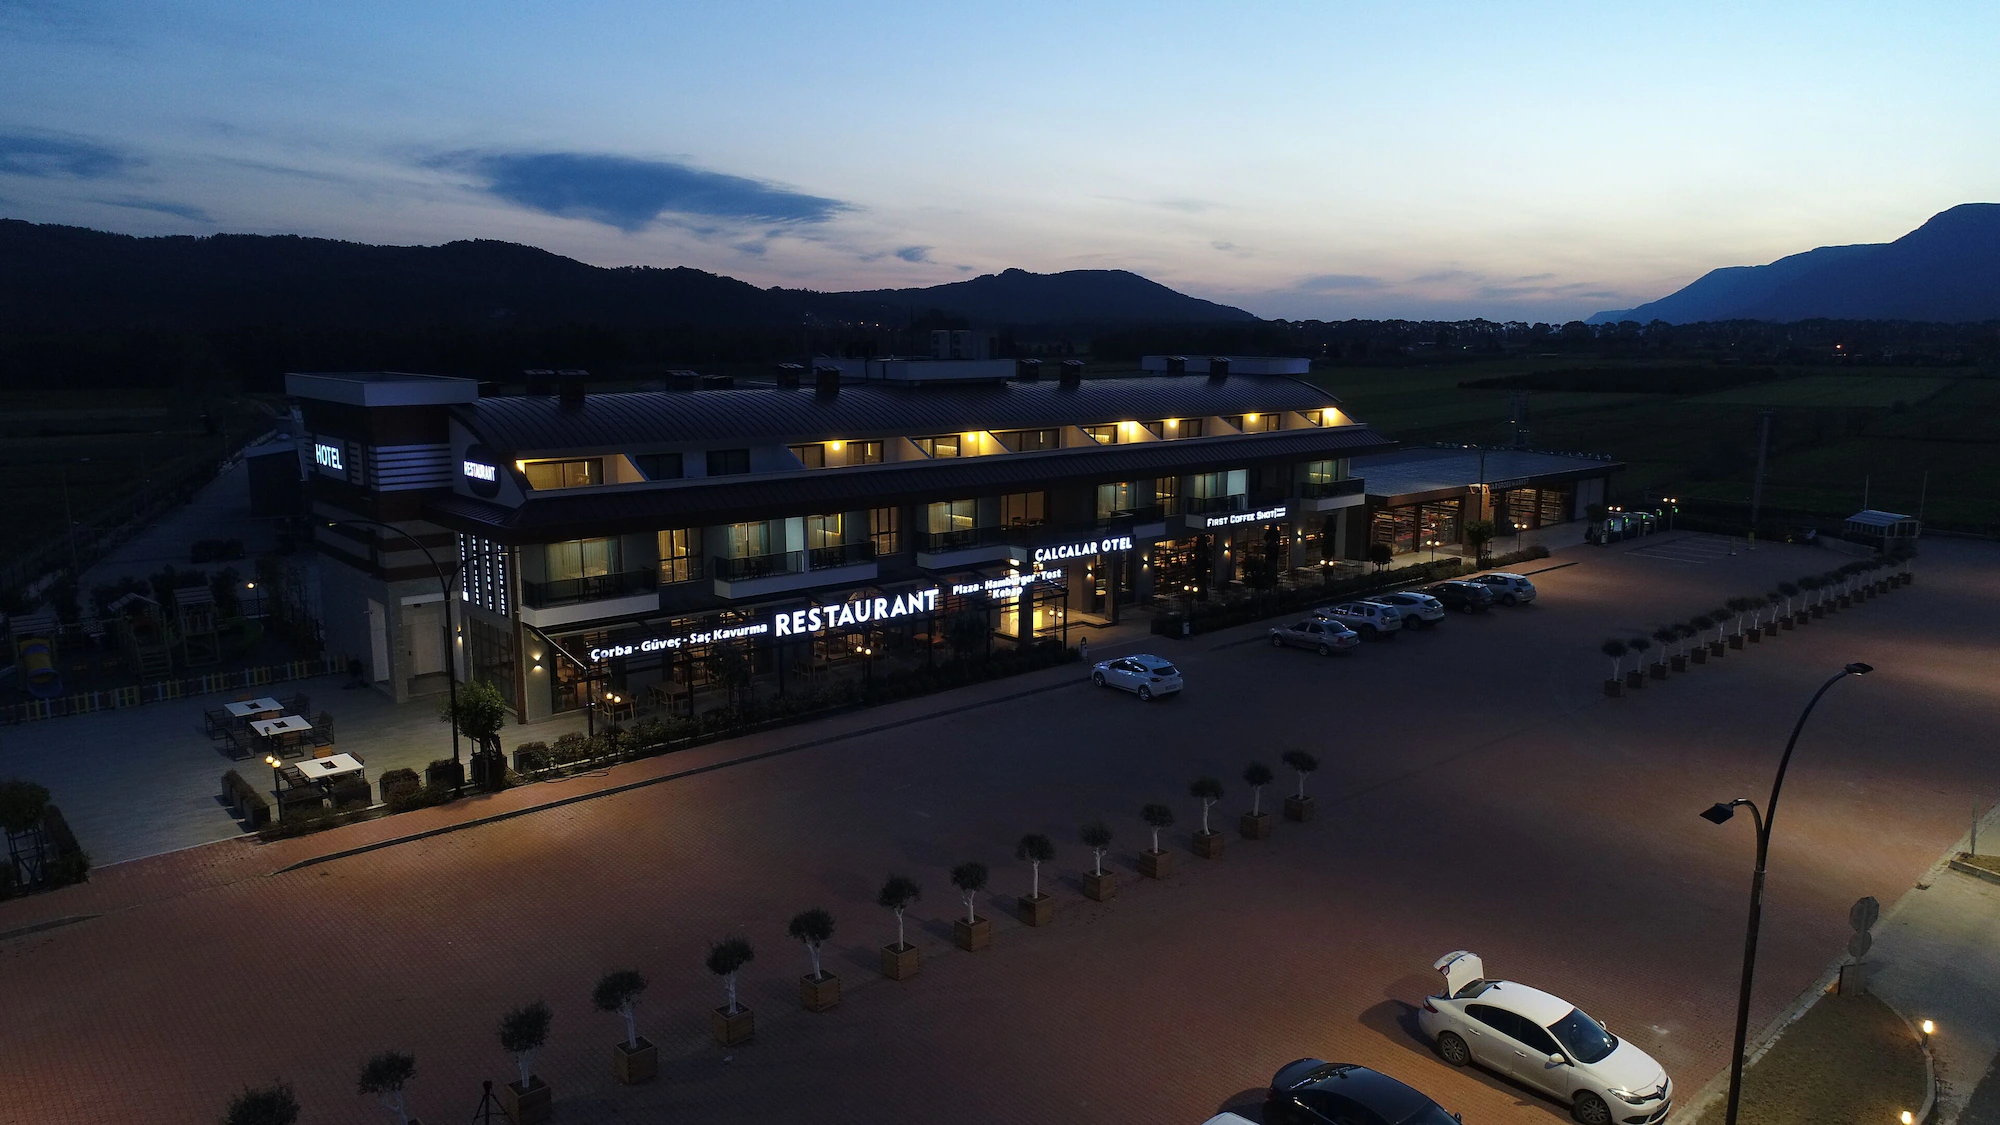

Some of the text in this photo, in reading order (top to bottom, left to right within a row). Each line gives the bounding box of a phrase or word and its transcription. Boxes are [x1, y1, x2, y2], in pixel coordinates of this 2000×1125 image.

[315, 443, 343, 470] HOTEL
[1207, 517, 1228, 527] FIRST
[1230, 513, 1256, 524] COFFEE
[1101, 536, 1132, 552] OTEL
[952, 583, 979, 595] Pizza
[985, 572, 1036, 590] Hamburger
[1041, 568, 1062, 580] Tost
[992, 586, 1023, 599] Kebap
[775, 588, 939, 637] RESTAURANT
[590, 644, 632, 662] Çorba
[641, 636, 681, 652] Güveç
[690, 631, 711, 644] Saç
[713, 623, 767, 640] Kavurma
